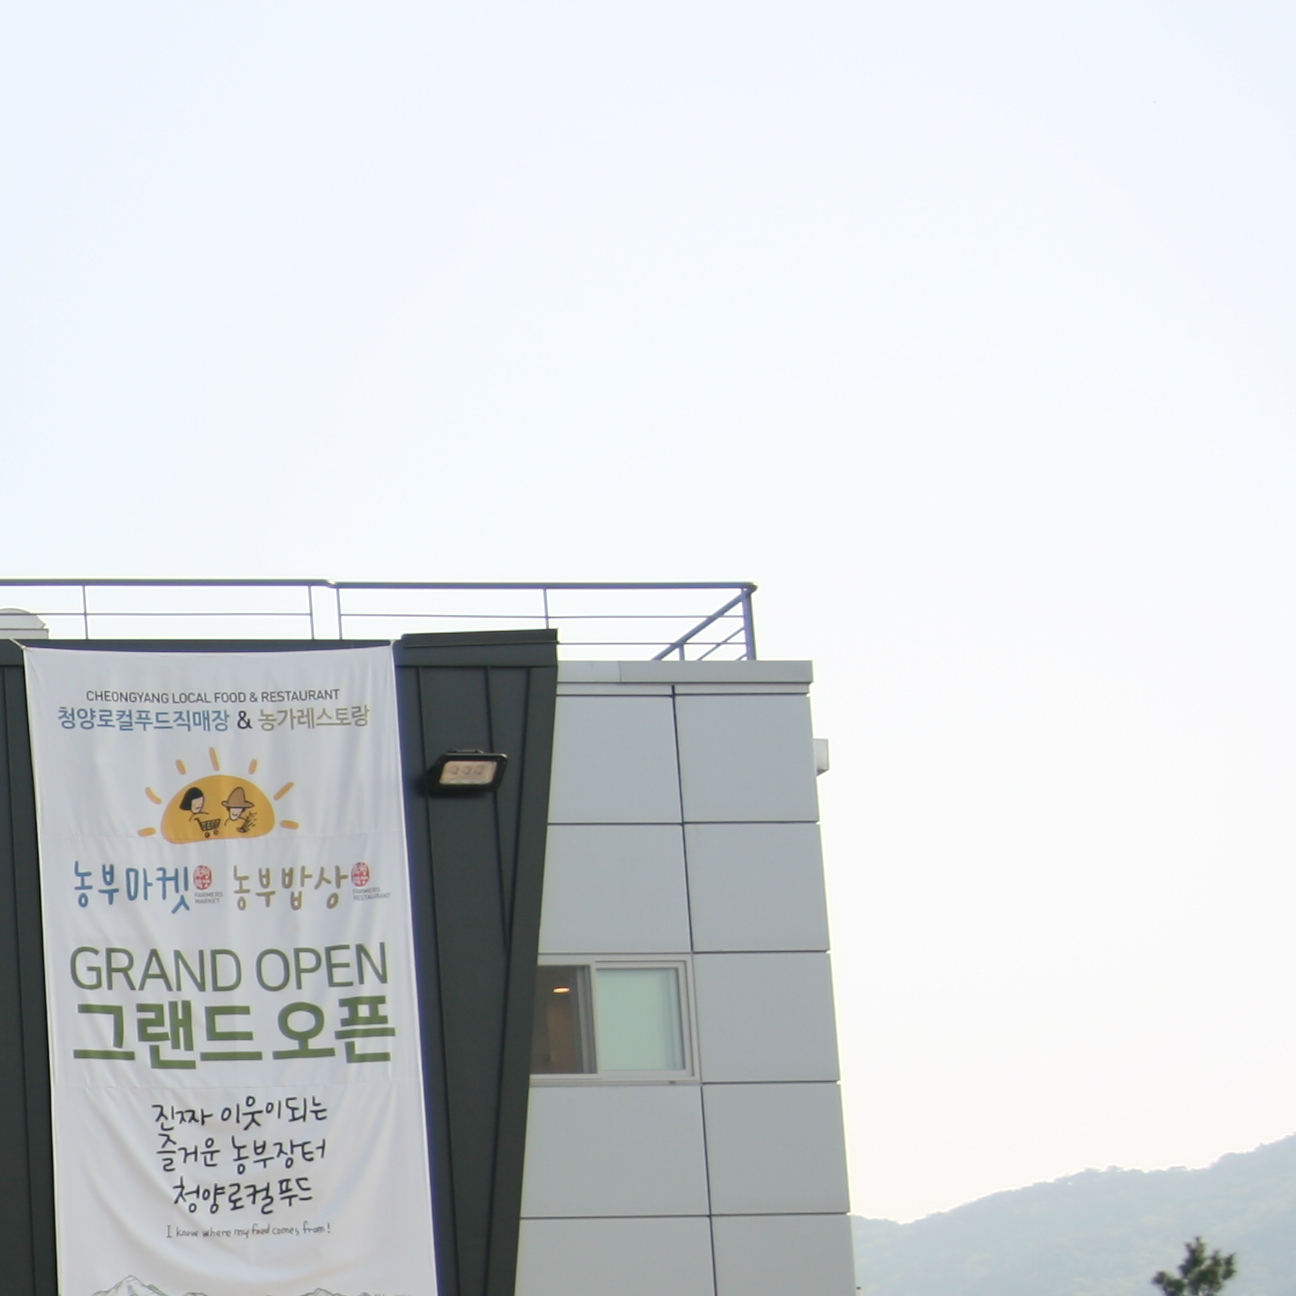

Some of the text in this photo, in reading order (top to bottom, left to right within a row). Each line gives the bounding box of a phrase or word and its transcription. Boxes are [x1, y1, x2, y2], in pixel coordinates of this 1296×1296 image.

[86, 689, 339, 704] CHEONGYANG LOCAL FOOD & RESTAURANT
[57, 705, 370, 732] 청양로컬푸드직매장 & 농가레스토랑
[74, 861, 191, 914] 농부마켓
[233, 864, 349, 911] 농부밥상
[70, 942, 388, 992] GRAND OPEN
[73, 994, 396, 1069] 그랜드 오픈
[151, 1104, 213, 1131] 진짜
[156, 1134, 326, 1175] 즐거운 농부장터
[172, 1177, 313, 1214] 청양로컬푸드
[166, 1224, 172, 1238] I
[176, 1226, 198, 1237] know
[202, 1226, 231, 1237] where
[234, 1228, 249, 1239] my
[251, 1223, 270, 1235] food
[272, 1226, 299, 1236] comes
